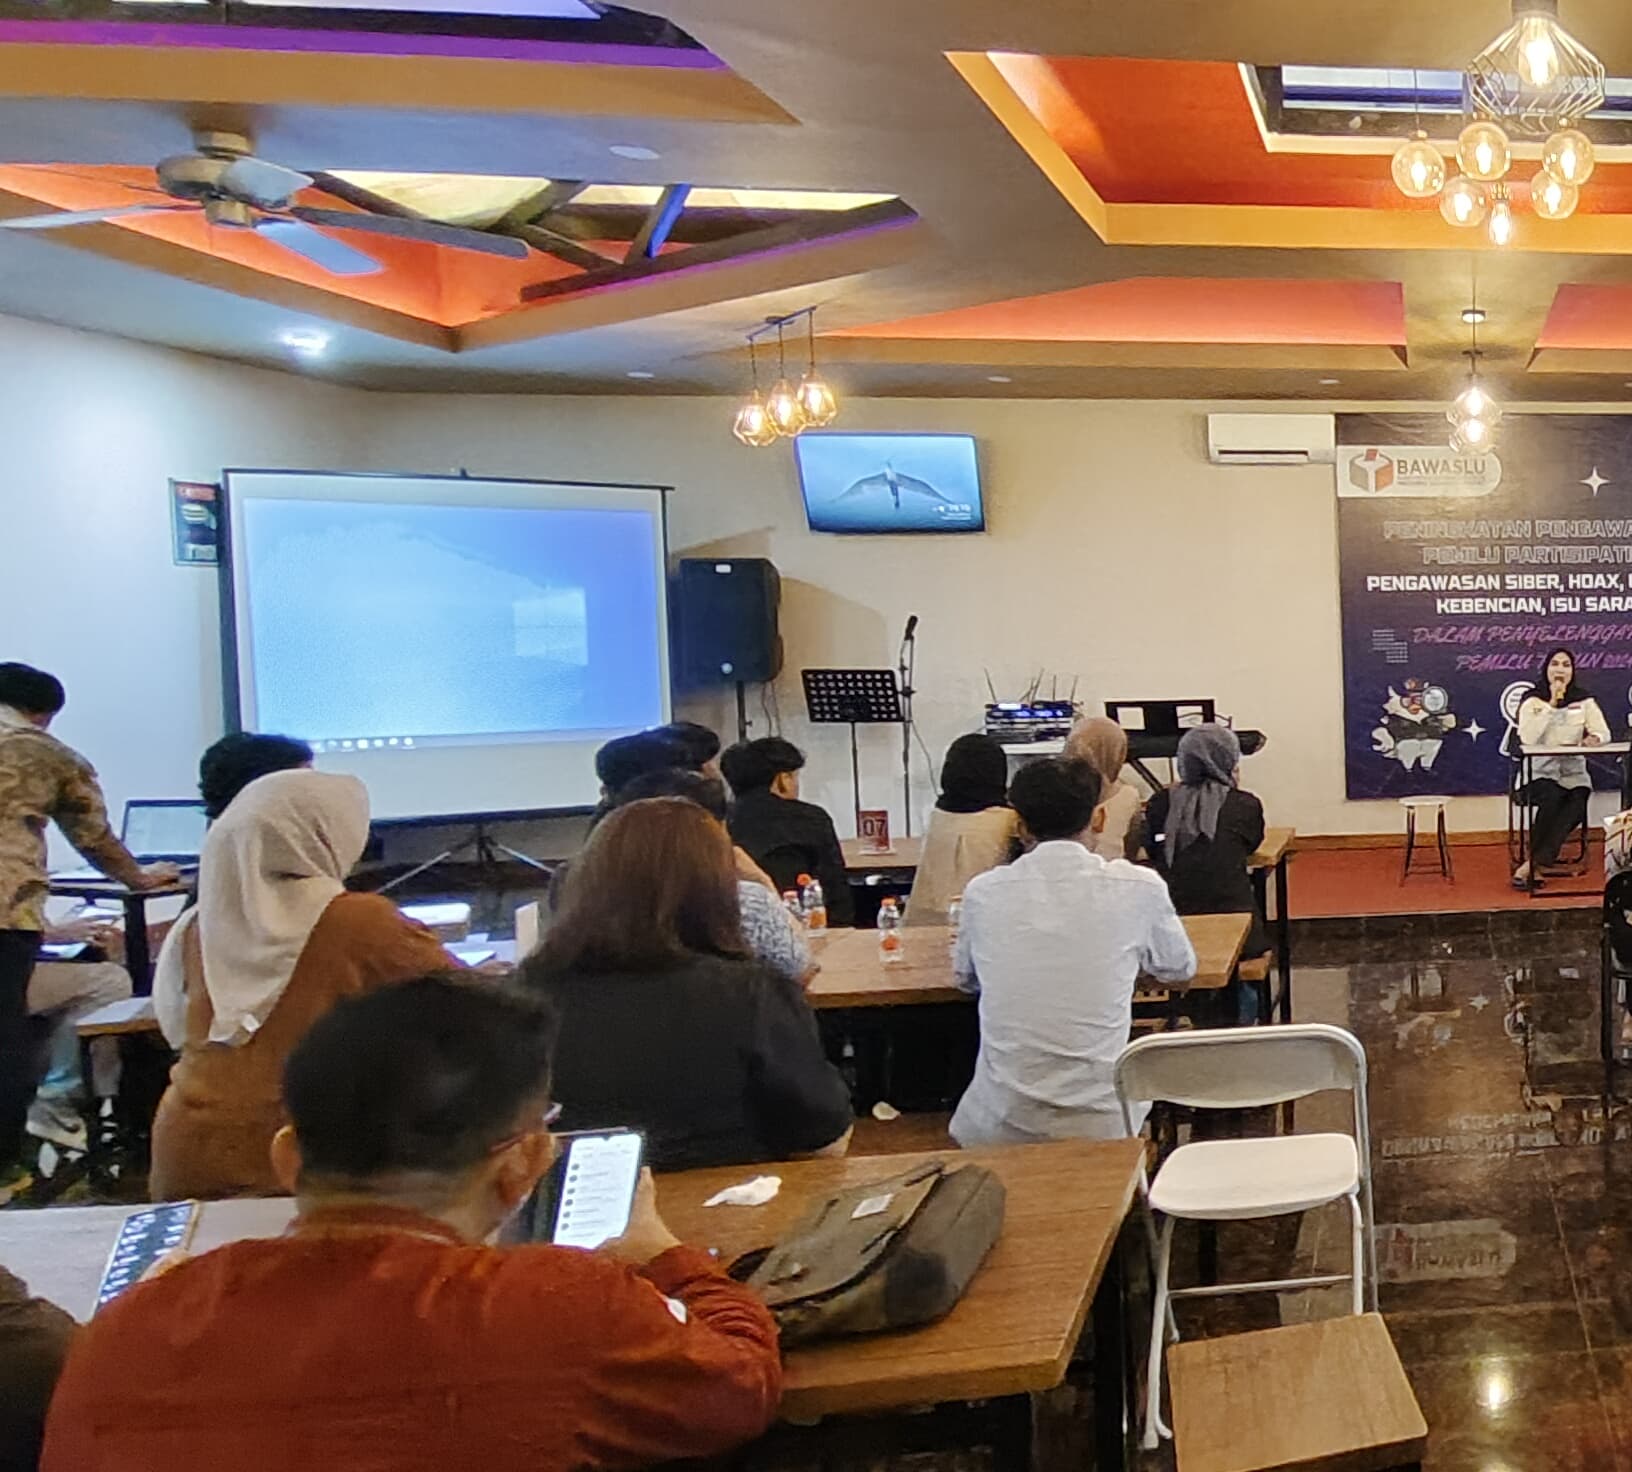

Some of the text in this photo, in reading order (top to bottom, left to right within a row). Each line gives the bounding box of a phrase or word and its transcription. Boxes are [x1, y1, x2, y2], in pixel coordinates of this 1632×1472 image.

[1397, 459, 1486, 475] BAWASLU
[1366, 574, 1501, 592] PENGAWASAN
[1505, 573, 1565, 592] SIBER,
[1569, 573, 1625, 592] HOAX,
[1436, 597, 1547, 616] KEBENCIAN,
[1551, 597, 1581, 613] ISU
[1412, 626, 1484, 644] DALAM
[1455, 653, 1533, 673] PEMILU
[1535, 652, 1602, 674] TUN
[862, 818, 885, 837] 07
